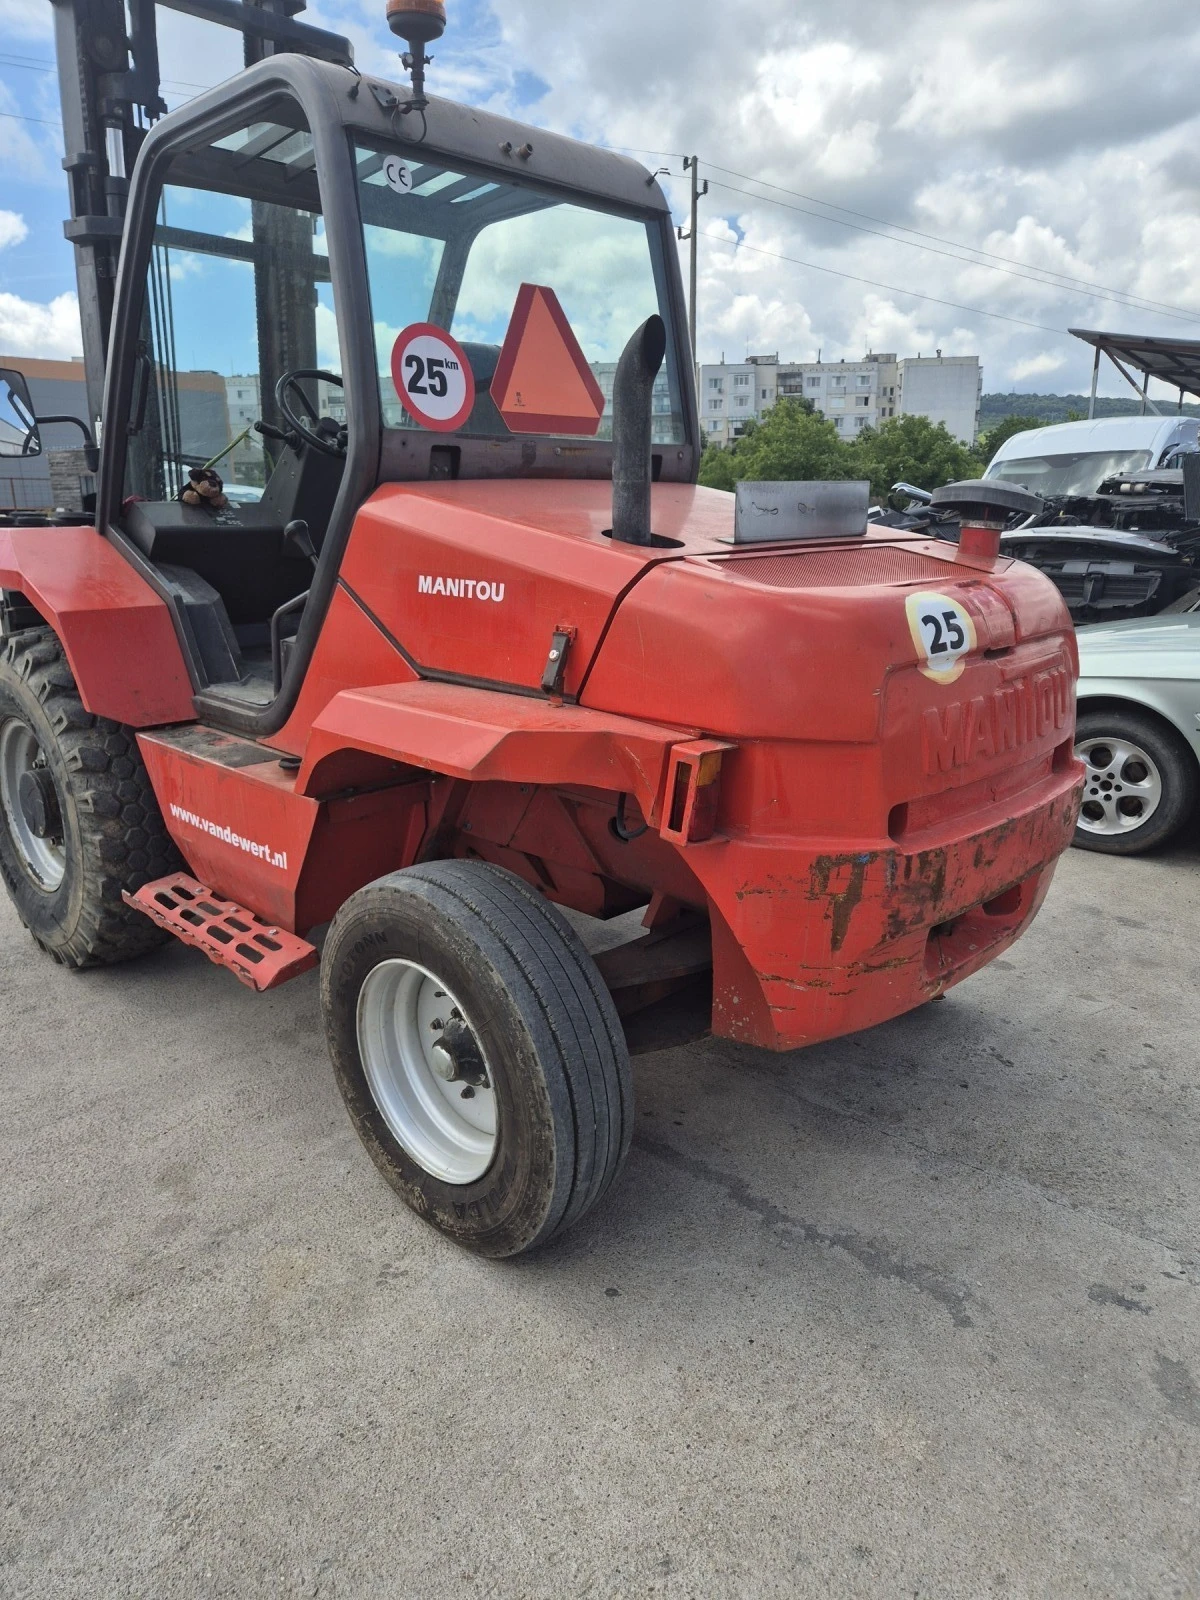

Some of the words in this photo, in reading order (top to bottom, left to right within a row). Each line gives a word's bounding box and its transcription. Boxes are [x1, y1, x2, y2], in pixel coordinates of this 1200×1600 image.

[387, 162, 410, 189] CE
[404, 353, 447, 398] 25
[443, 357, 459, 372] km
[418, 574, 505, 602] MANITOU
[921, 610, 965, 655] 25
[921, 667, 1069, 776] MANITOU
[169, 802, 288, 870] www.vandewert.nl
